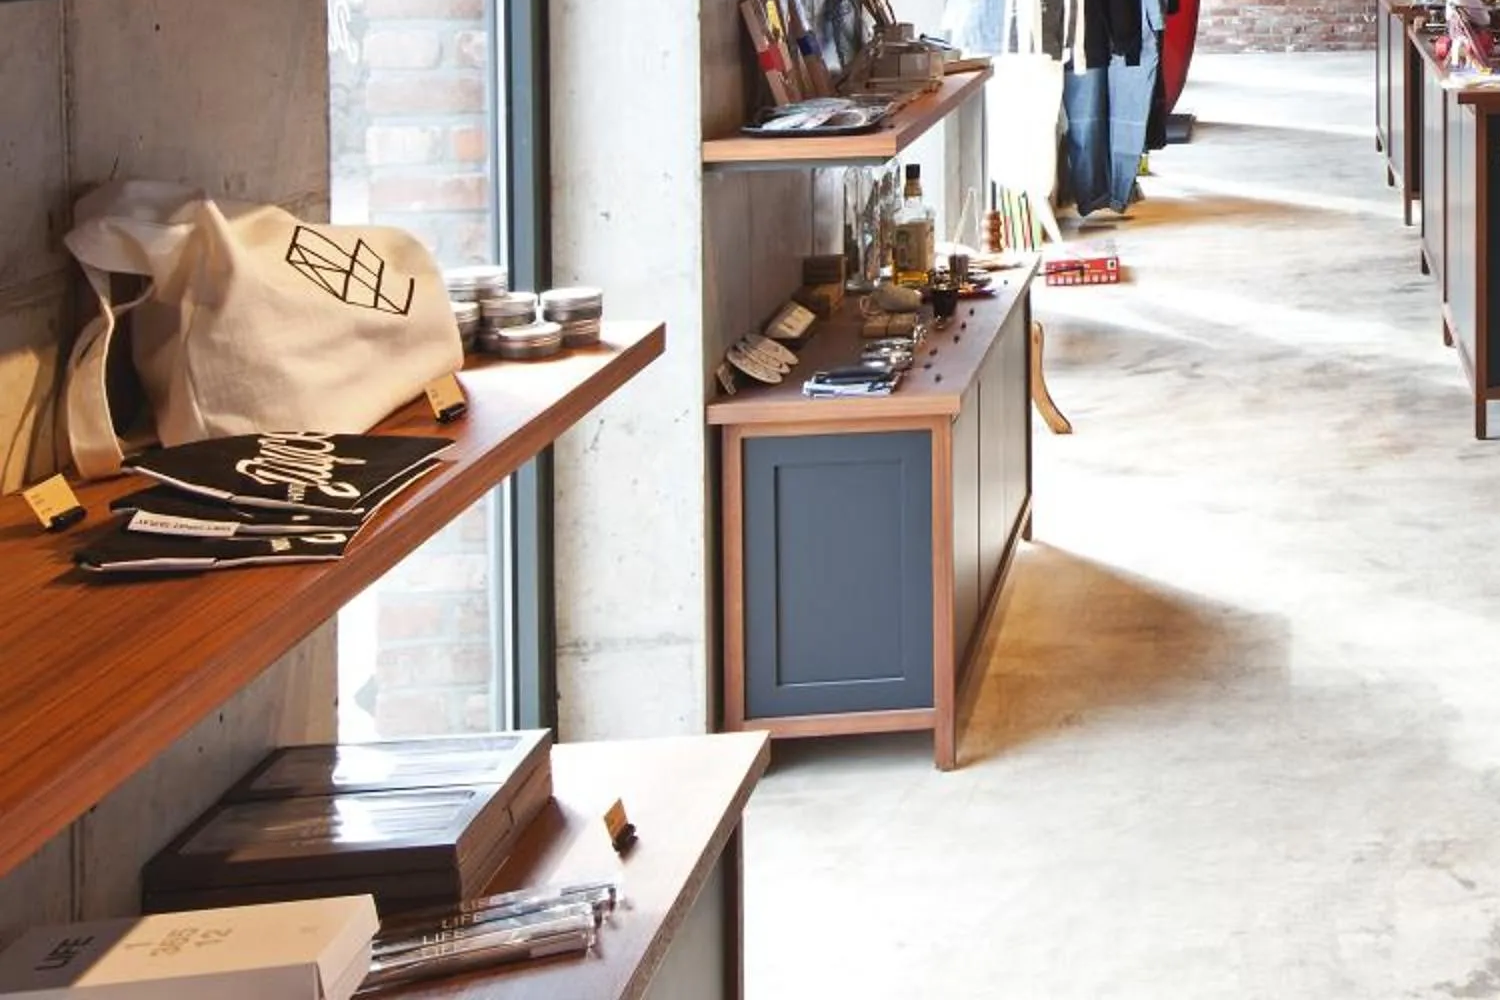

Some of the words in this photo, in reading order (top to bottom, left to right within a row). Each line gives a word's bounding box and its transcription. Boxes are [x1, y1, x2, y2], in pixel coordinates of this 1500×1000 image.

[442, 912, 483, 929] LIFE
[423, 928, 466, 945] LIFE
[34, 934, 95, 972] LIFE
